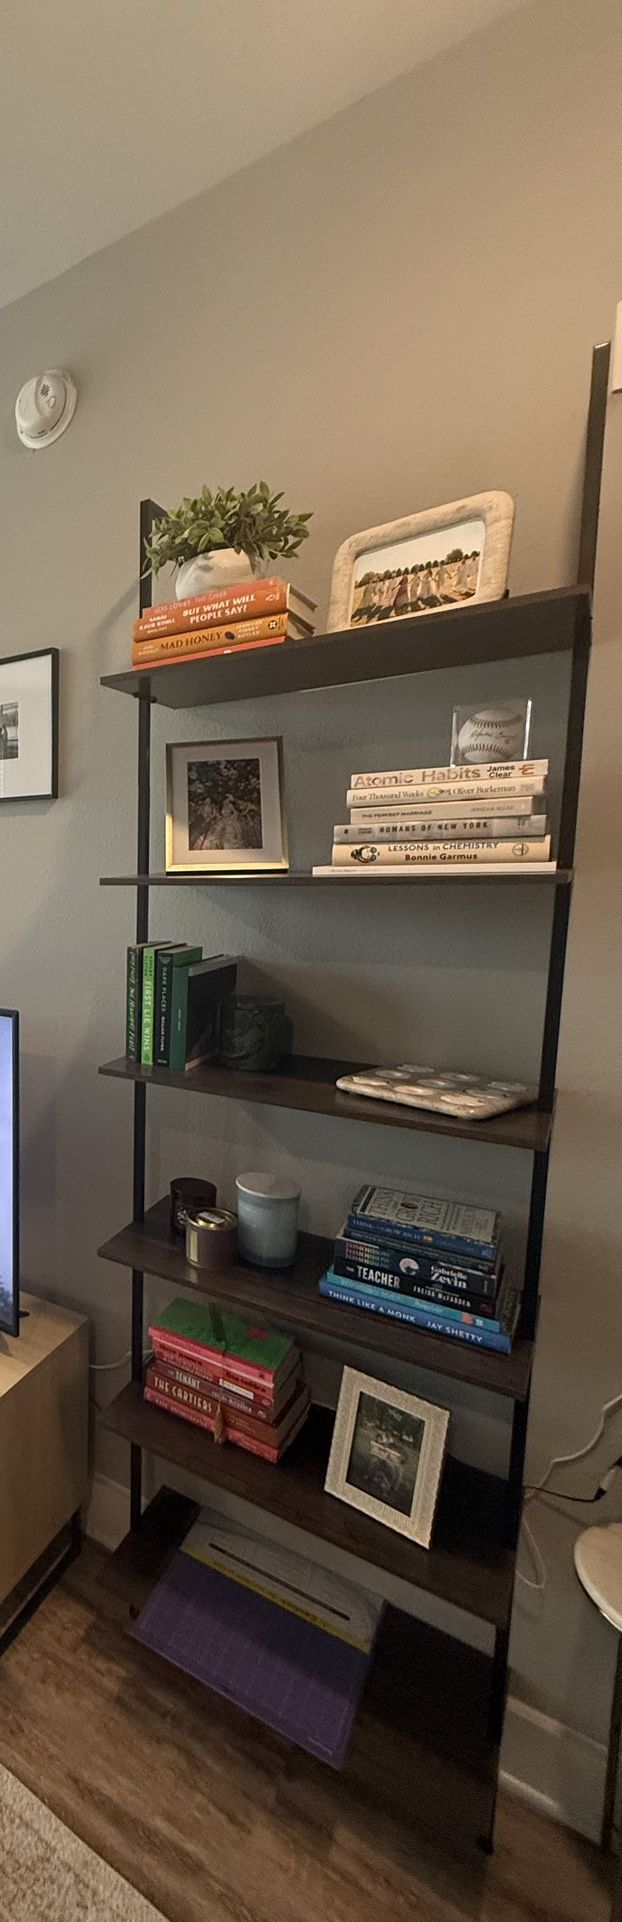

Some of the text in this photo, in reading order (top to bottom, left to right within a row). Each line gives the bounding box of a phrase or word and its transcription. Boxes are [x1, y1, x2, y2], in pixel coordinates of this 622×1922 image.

[182, 594, 255, 617] BUT WHAT WILL
[190, 604, 248, 624] PEOPLE SAY?
[161, 639, 184, 650] MAD
[185, 631, 223, 646] HONEY
[354, 767, 481, 787] Atomic Habits
[487, 765, 515, 773] James
[489, 771, 512, 779] Clear
[352, 789, 424, 801] Four Thousand Weeks
[453, 787, 474, 795] Oliver
[379, 825, 416, 833] HUMANS
[463, 822, 488, 830] YORK
[388, 844, 429, 852] LESSONS
[442, 842, 499, 850] CHEMISTRY
[405, 853, 437, 861] Bonnie
[143, 980, 152, 1050] FIRST LIE WINS
[356, 1265, 400, 1289] TEACHER
[430, 1265, 468, 1280] Gabrielle
[430, 1272, 467, 1289] Zevin
[328, 1290, 355, 1303] THINK
[356, 1299, 377, 1311] LIKE
[387, 1309, 416, 1323] MONK
[426, 1321, 483, 1342] JAY SHETTY
[175, 1371, 201, 1390] TENANT
[154, 1376, 169, 1393] THE
[172, 1386, 212, 1413] CARTIERS
